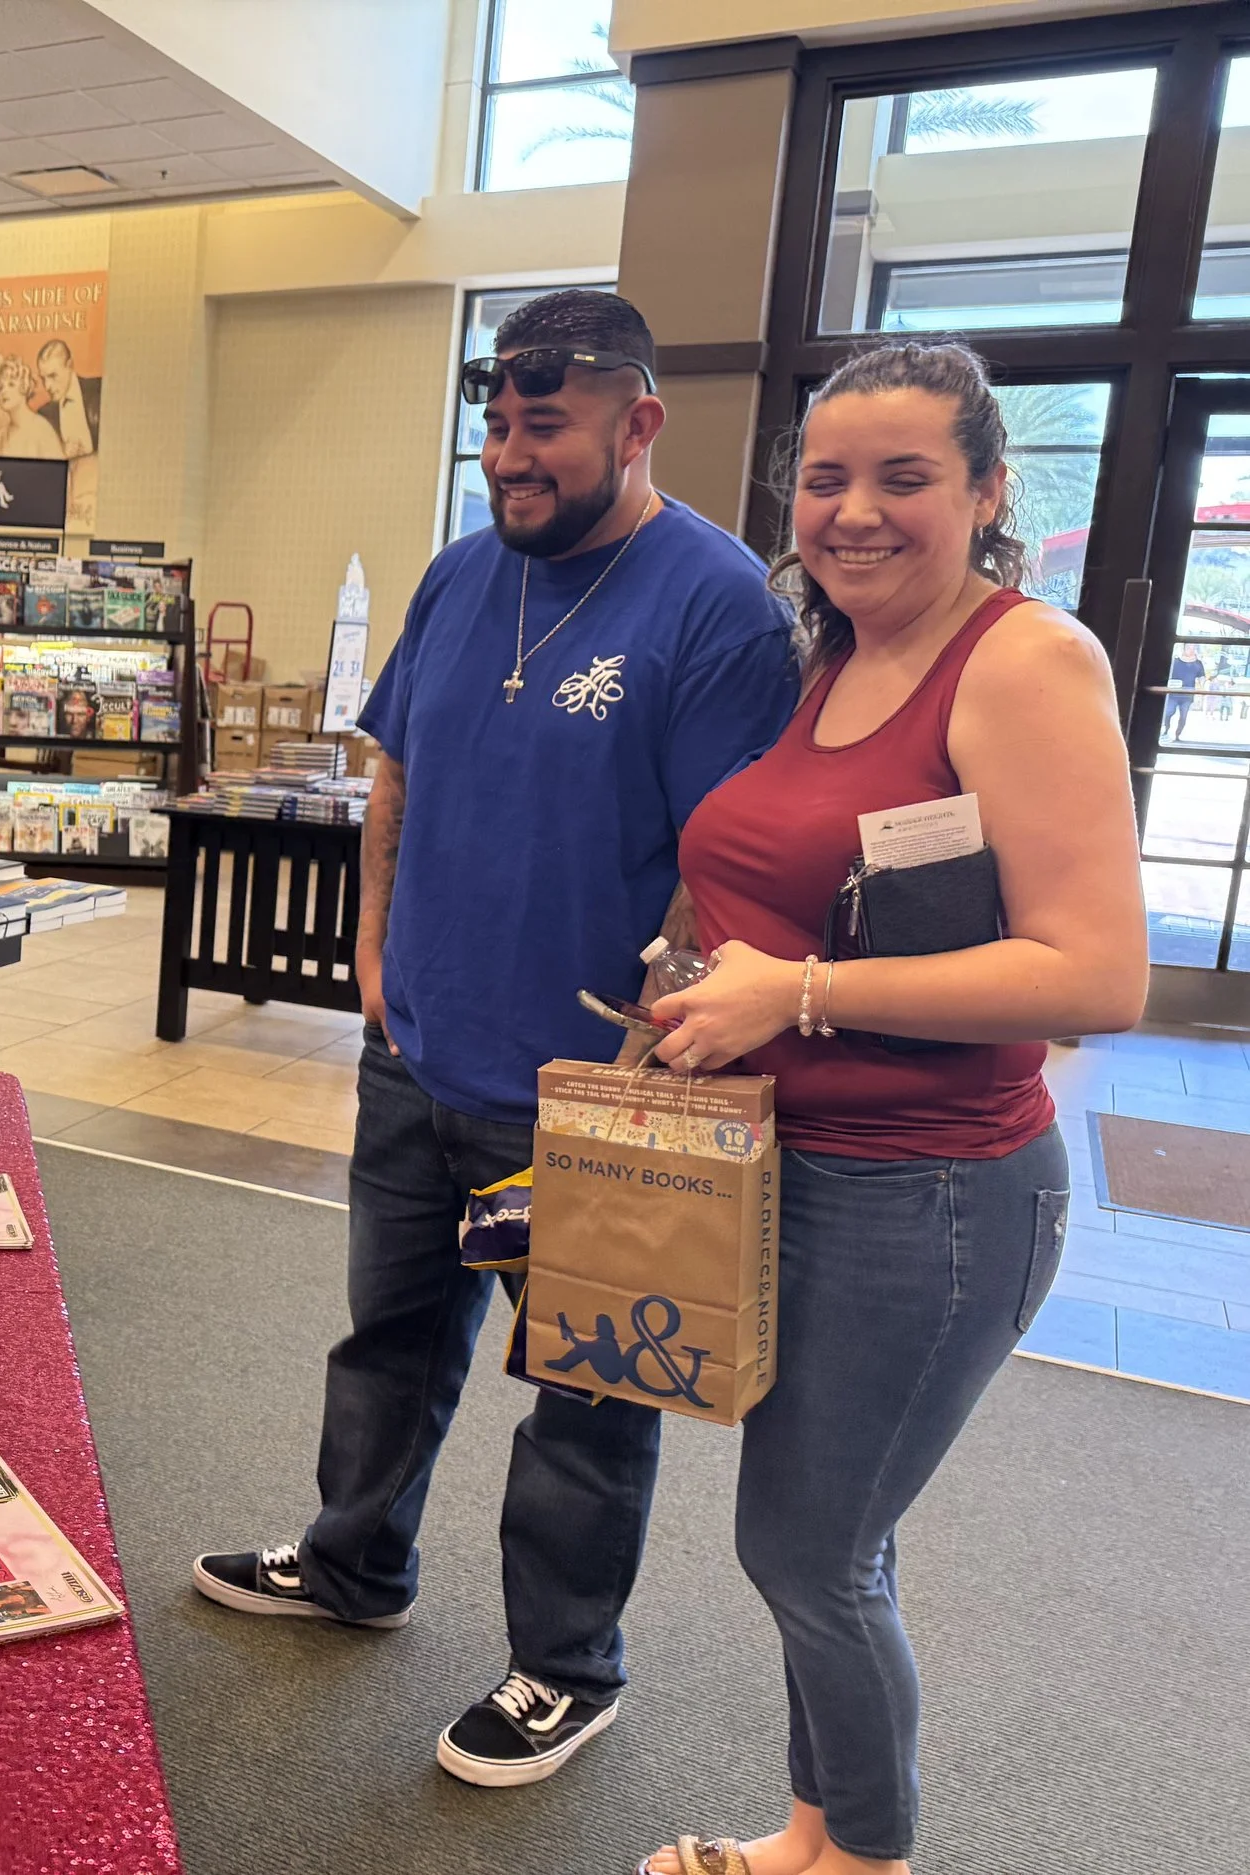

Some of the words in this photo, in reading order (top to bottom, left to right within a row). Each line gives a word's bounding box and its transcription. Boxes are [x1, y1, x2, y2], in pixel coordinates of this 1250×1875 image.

[22, 285, 67, 308] SIDE
[73, 282, 103, 305] OF
[111, 544, 143, 553] Business
[586, 1090, 600, 1098] TAIL
[600, 1084, 621, 1093] BUNNY
[655, 1091, 674, 1099] TAILS
[719, 1122, 748, 1133] INCLUDES
[724, 1129, 746, 1146] 10
[723, 1144, 746, 1154] GAMES
[546, 1152, 572, 1170] SO
[578, 1157, 637, 1182] MANY
